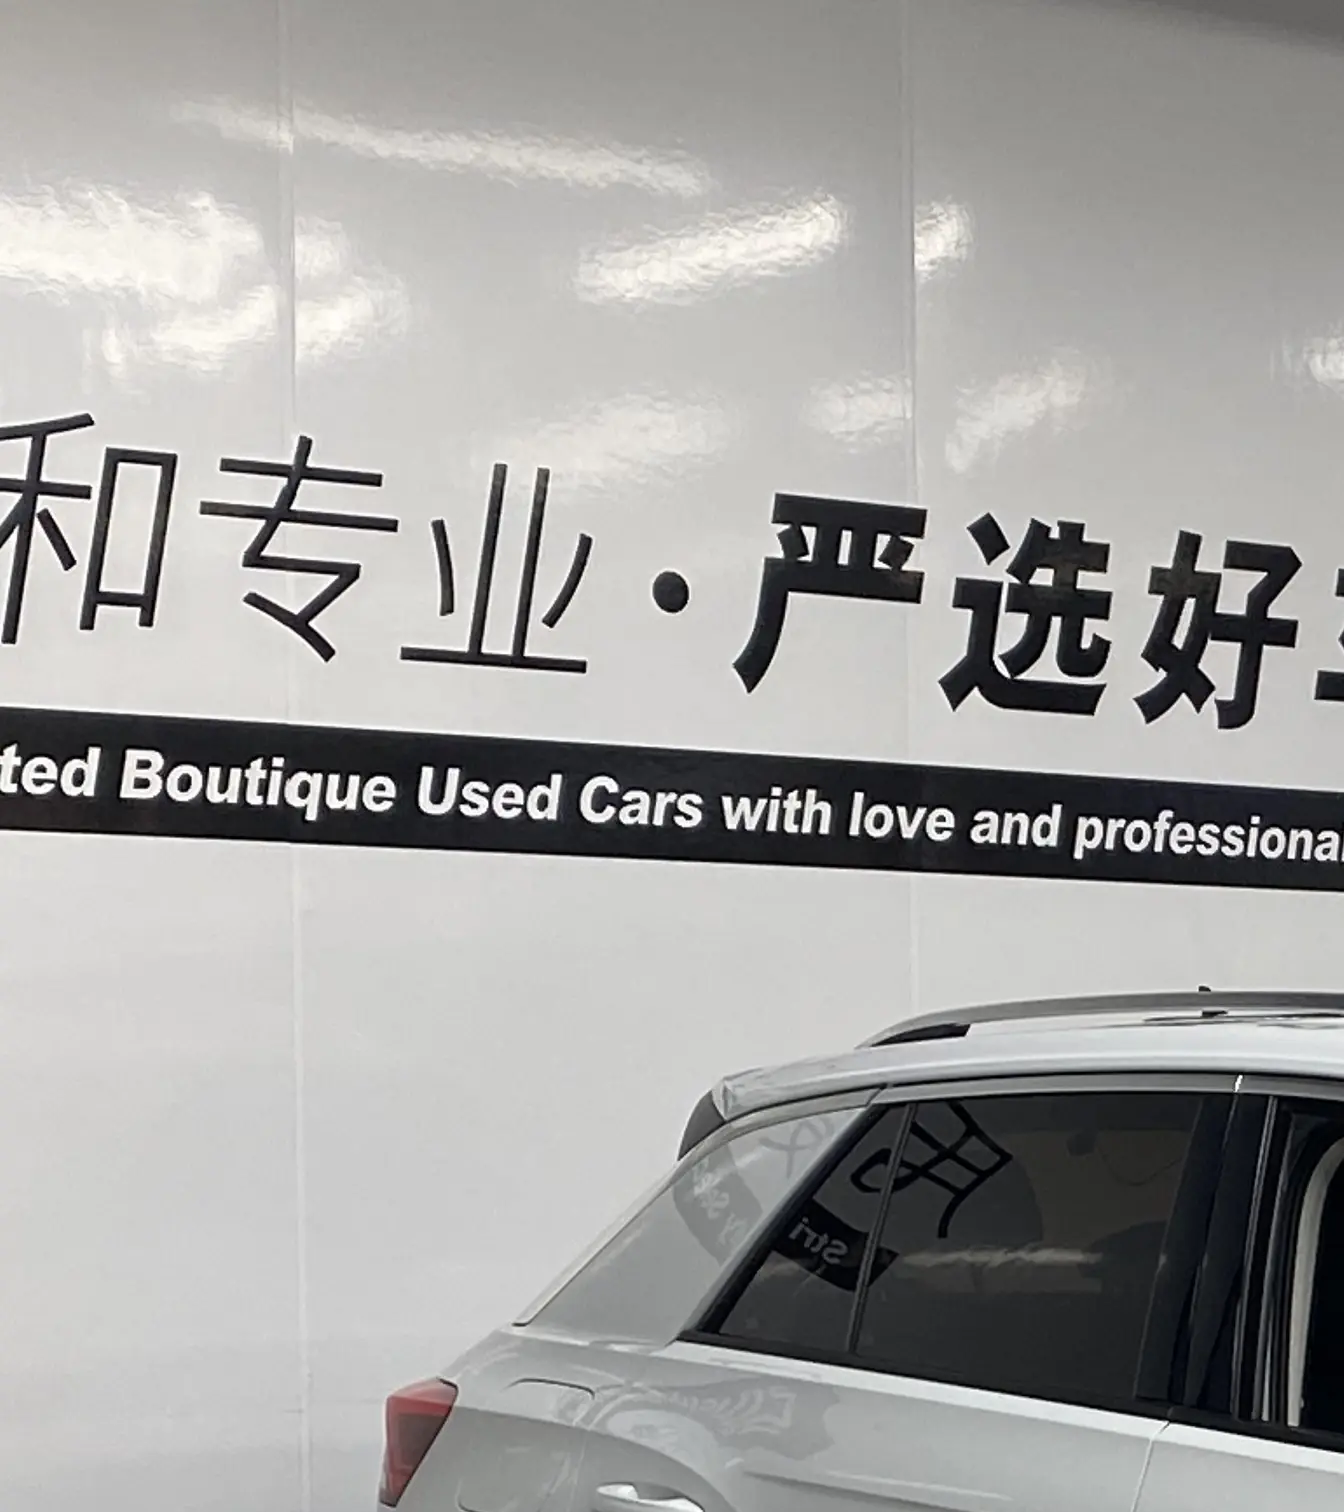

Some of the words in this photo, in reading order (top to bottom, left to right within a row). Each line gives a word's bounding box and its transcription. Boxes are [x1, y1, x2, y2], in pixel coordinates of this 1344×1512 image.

[119, 749, 398, 823] Boutique
[417, 766, 562, 822] Used
[580, 776, 702, 829] Cars
[721, 785, 832, 837] with
[850, 792, 956, 843] love
[970, 804, 1060, 849] and
